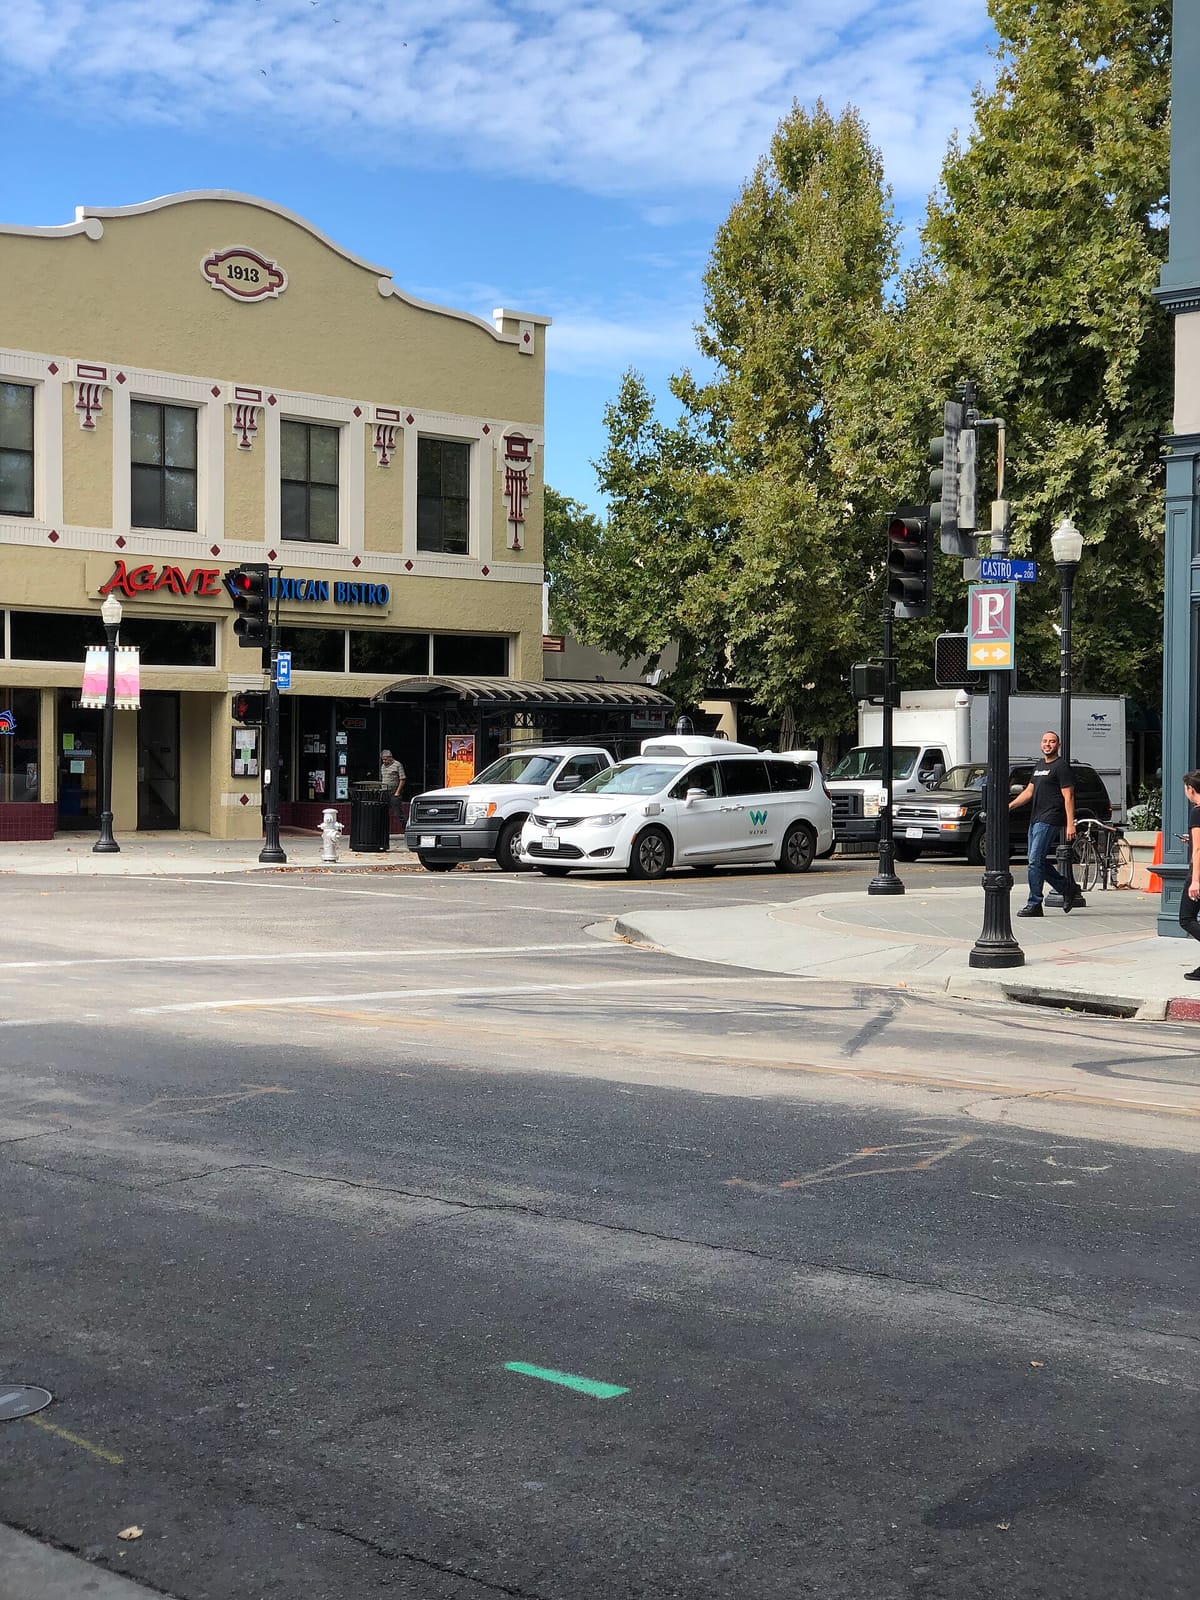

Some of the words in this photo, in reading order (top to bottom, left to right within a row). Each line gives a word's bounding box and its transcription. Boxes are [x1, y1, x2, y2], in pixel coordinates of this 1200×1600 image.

[226, 264, 260, 282] 1913
[982, 561, 1012, 578] CASTRO
[1023, 571, 1034, 579] 200
[98, 560, 221, 597] AGAVE
[335, 581, 389, 605] BISTRO
[977, 593, 1005, 634] P
